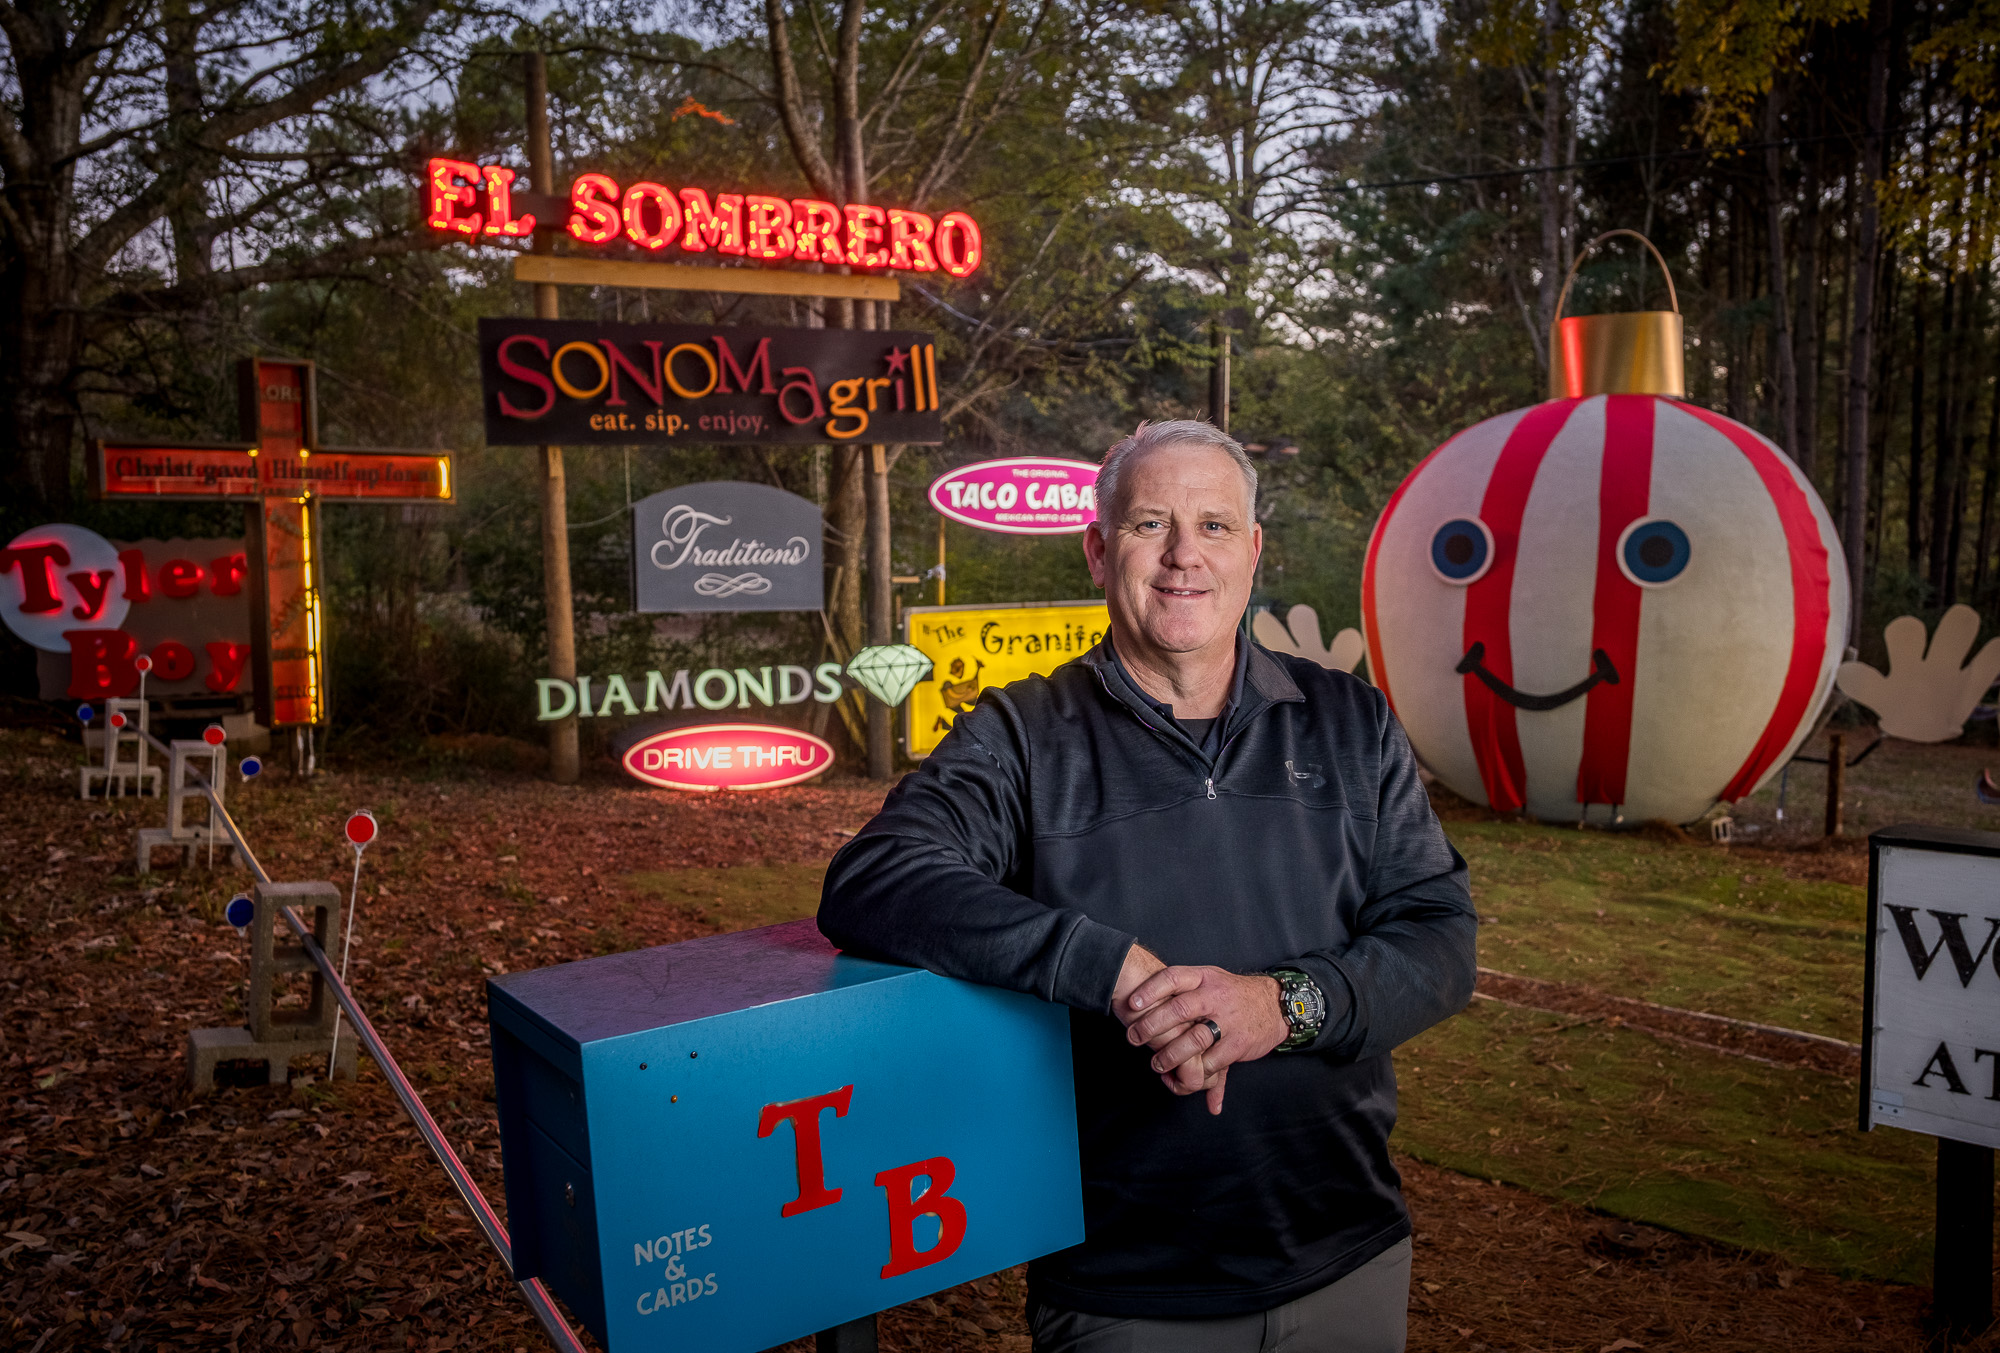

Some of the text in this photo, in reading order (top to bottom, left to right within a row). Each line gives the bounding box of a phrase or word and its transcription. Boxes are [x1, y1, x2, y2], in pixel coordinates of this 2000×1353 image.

[427, 156, 983, 278] EL SOMBRERO
[826, 343, 940, 440] grill
[589, 408, 770, 437] eat. sip. enjoy.
[114, 456, 194, 478] Christ
[1011, 468, 1029, 479] THE
[944, 480, 1096, 512] TACO CABA
[650, 503, 811, 571] Traditions
[0, 542, 248, 621] Tyler
[980, 621, 1104, 655] Granite
[63, 629, 251, 701] Boy
[536, 661, 843, 721] DIAMONDS
[642, 744, 816, 771] DRIVE THRU
[1883, 903, 2000, 988] W
[756, 1083, 968, 1280] T B
[634, 1223, 713, 1267] NOTES
[664, 1254, 687, 1282] &
[636, 1272, 719, 1316] CARDS
